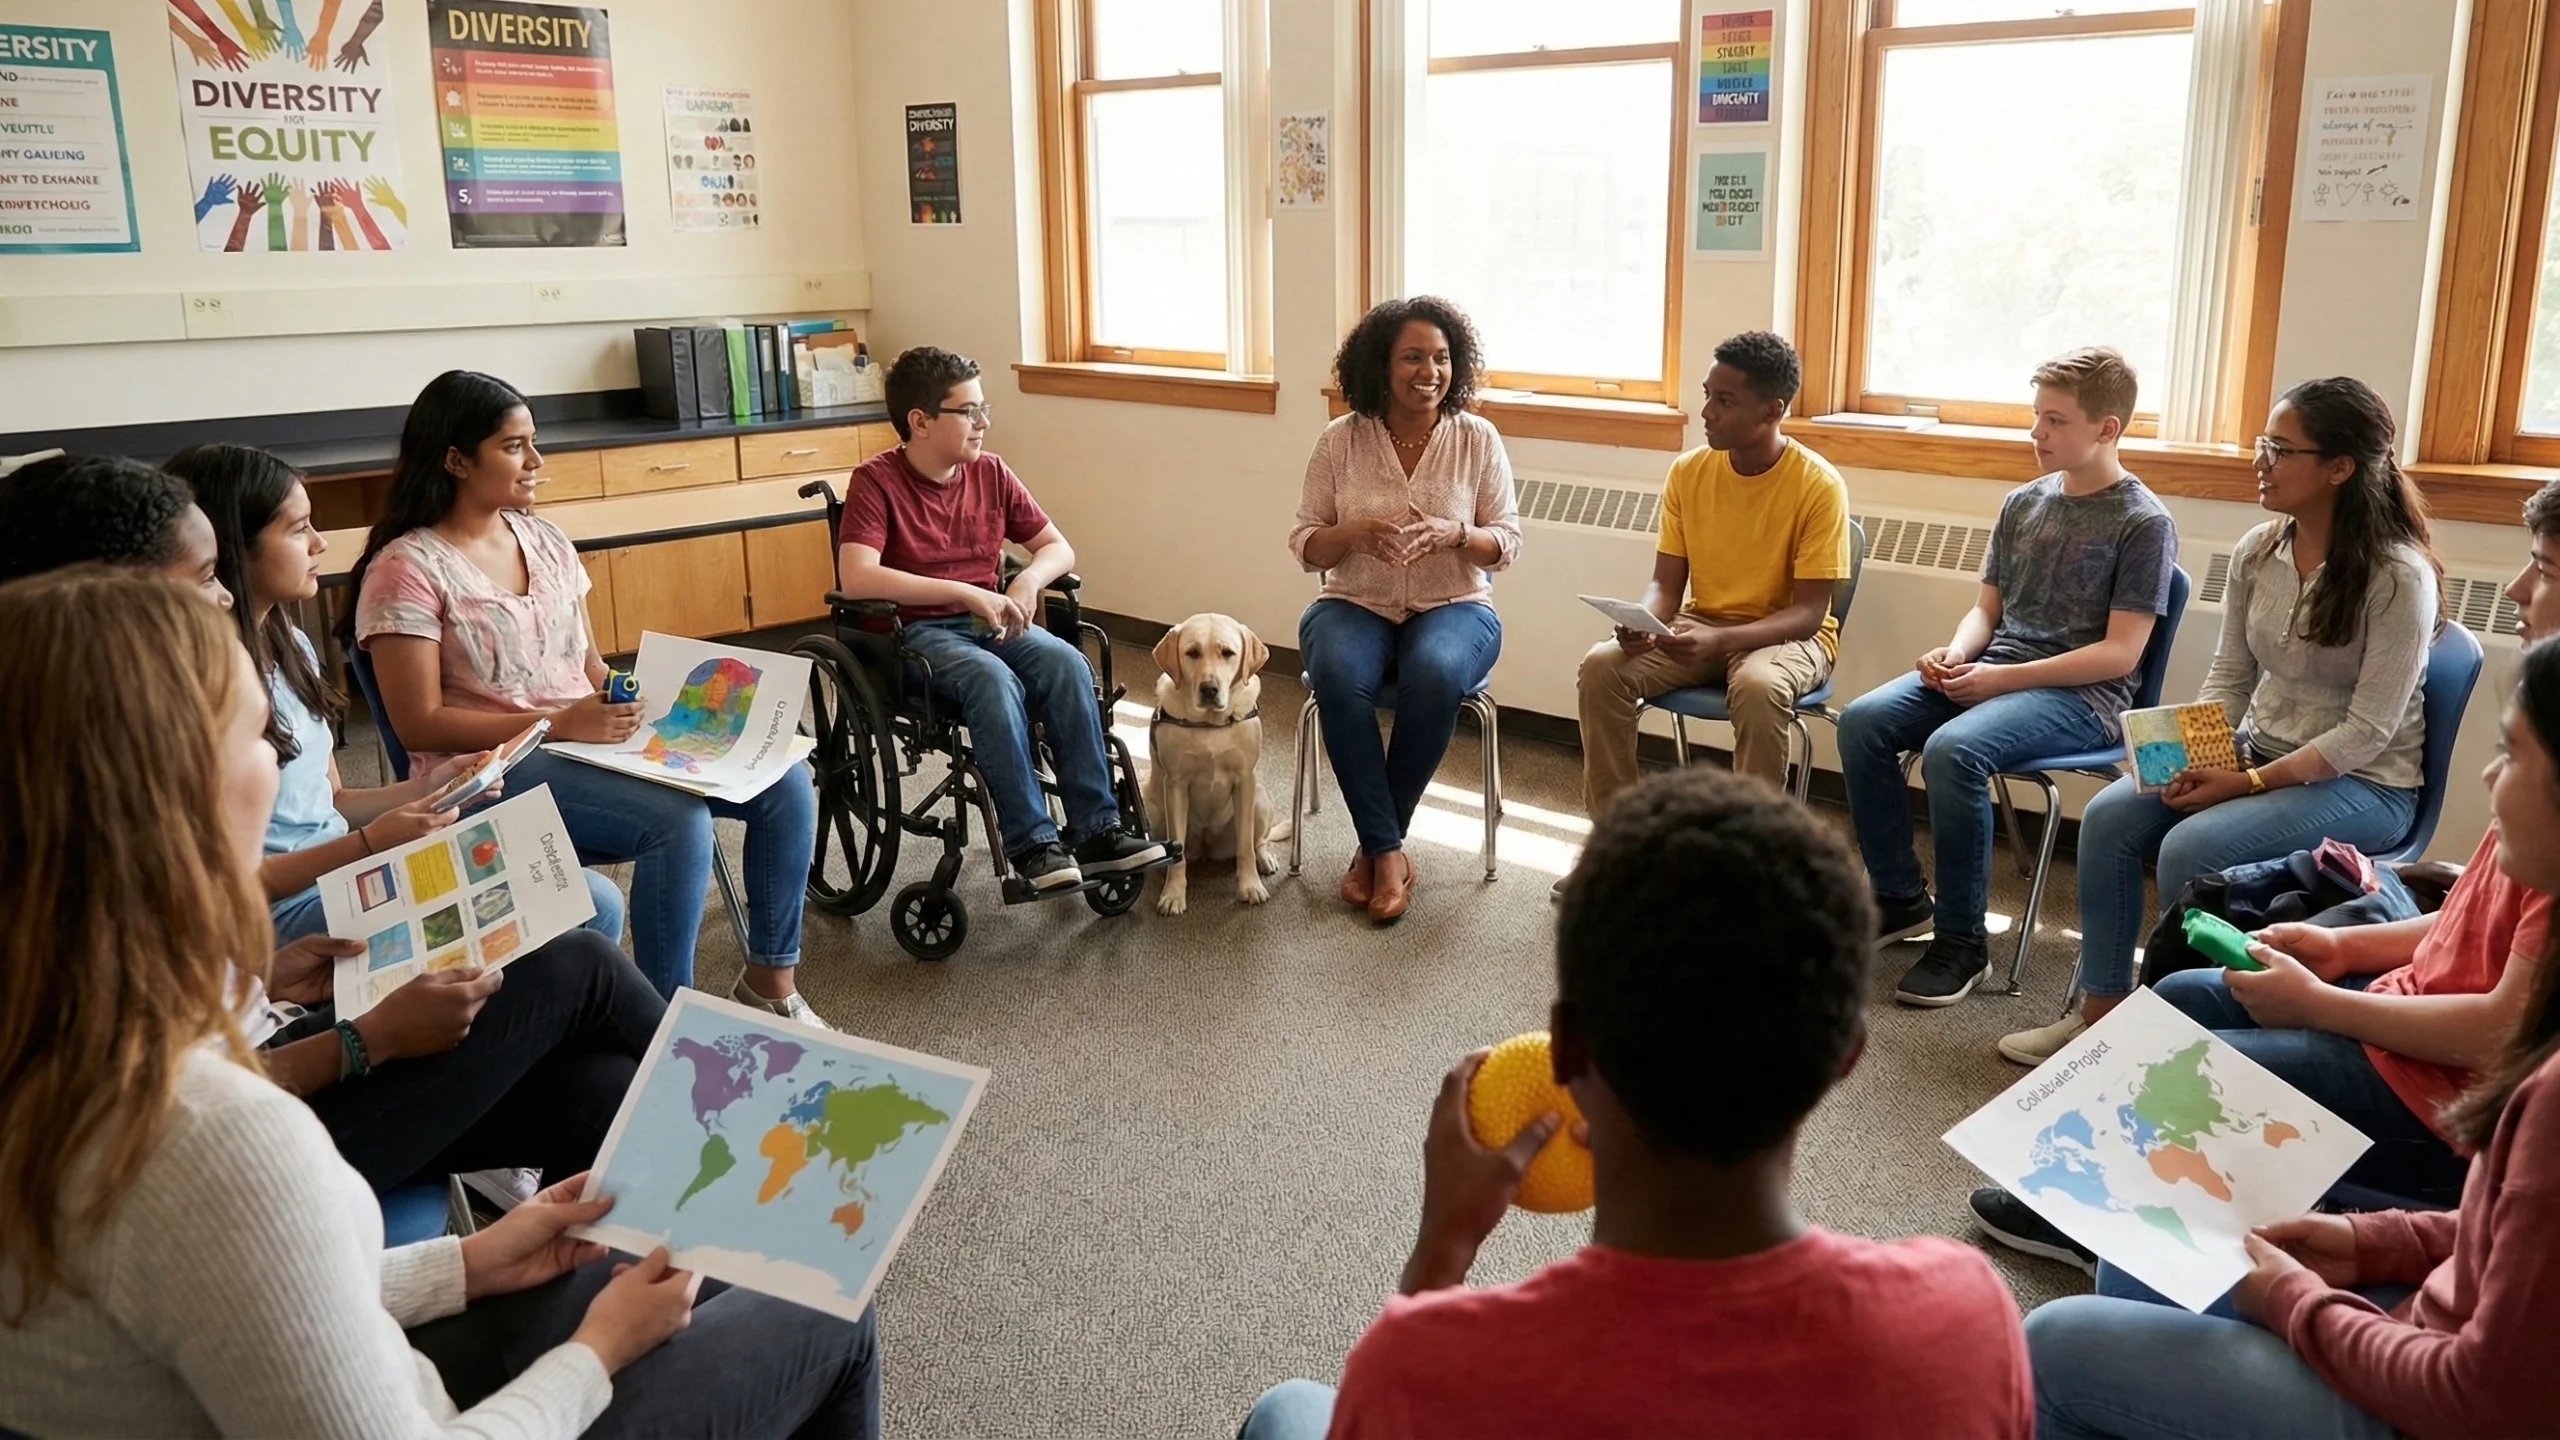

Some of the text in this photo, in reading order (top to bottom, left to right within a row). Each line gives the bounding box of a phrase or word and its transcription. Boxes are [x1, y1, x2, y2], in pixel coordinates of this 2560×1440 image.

[448, 9, 592, 48] DIVERSITY
[0, 33, 98, 62] ERSITY
[192, 79, 382, 113] DIVERSITY
[209, 125, 376, 163] EQUITY
